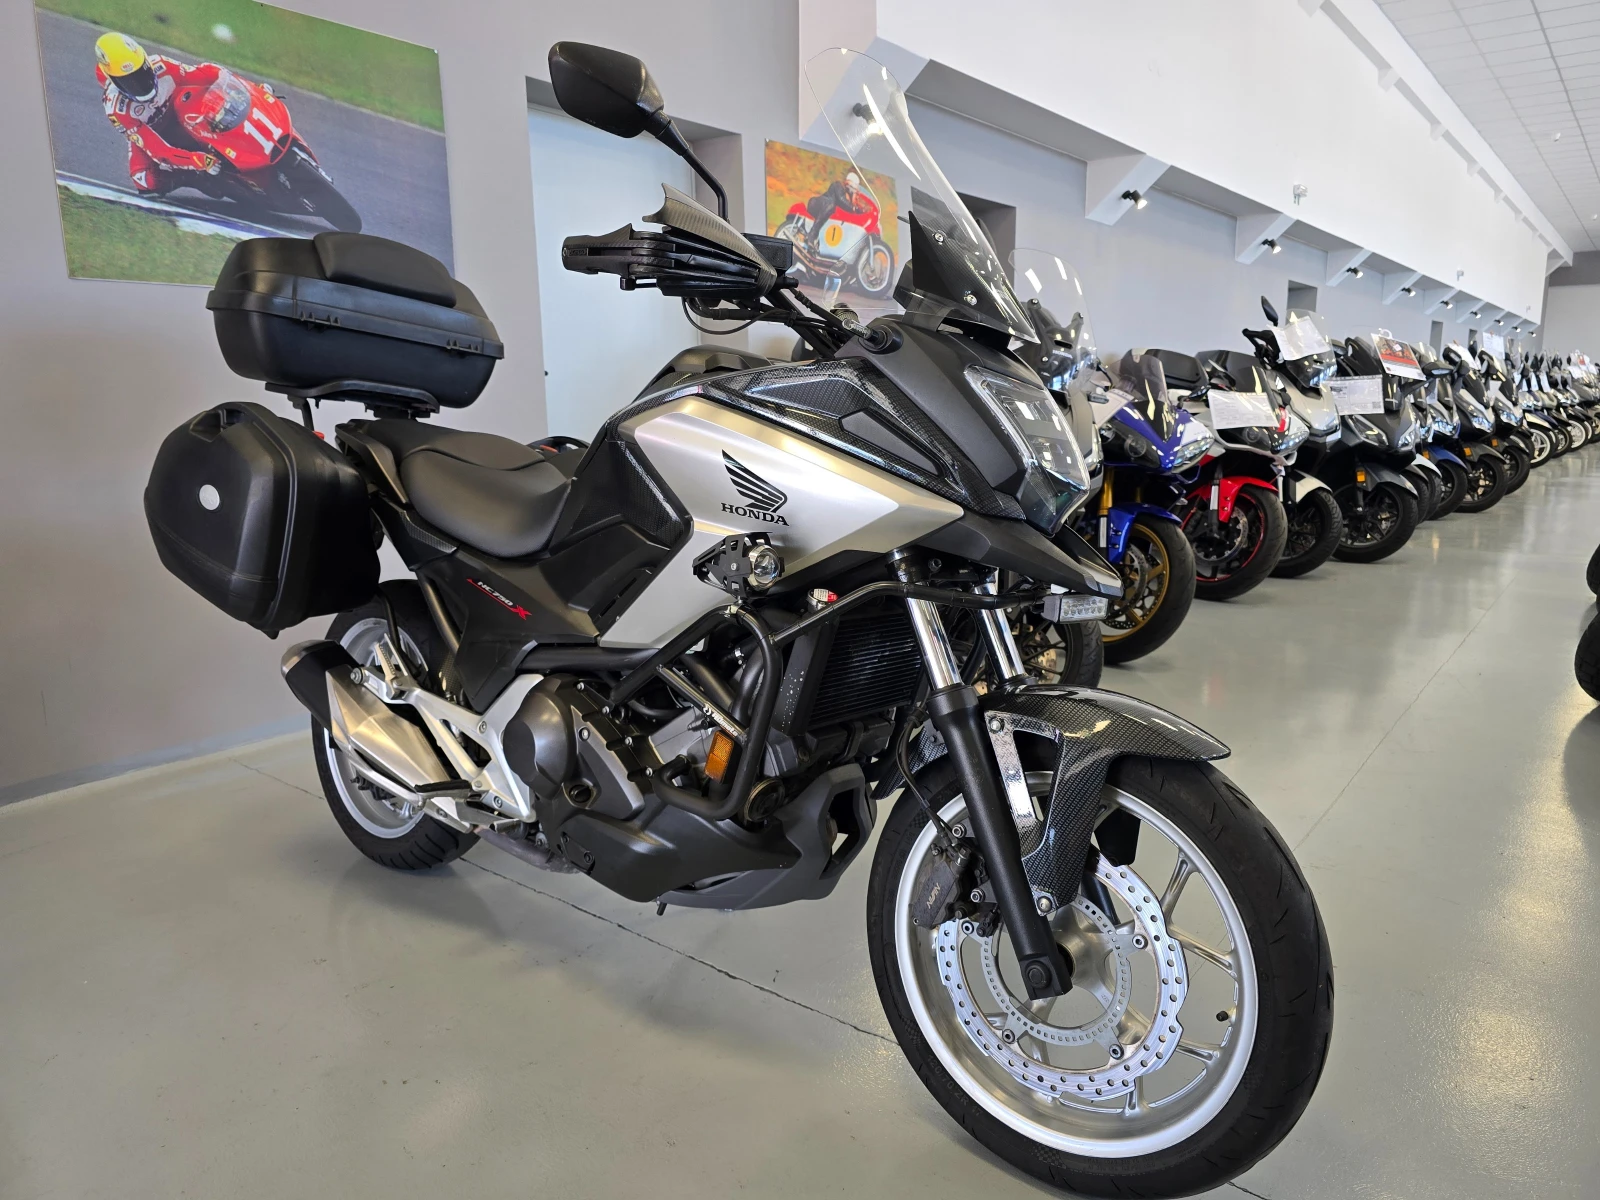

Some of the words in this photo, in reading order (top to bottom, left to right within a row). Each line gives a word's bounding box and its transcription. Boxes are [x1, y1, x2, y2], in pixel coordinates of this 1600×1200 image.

[244, 107, 283, 156] 11
[720, 502, 790, 526] HONDA
[954, 1088, 970, 1106] ZR
